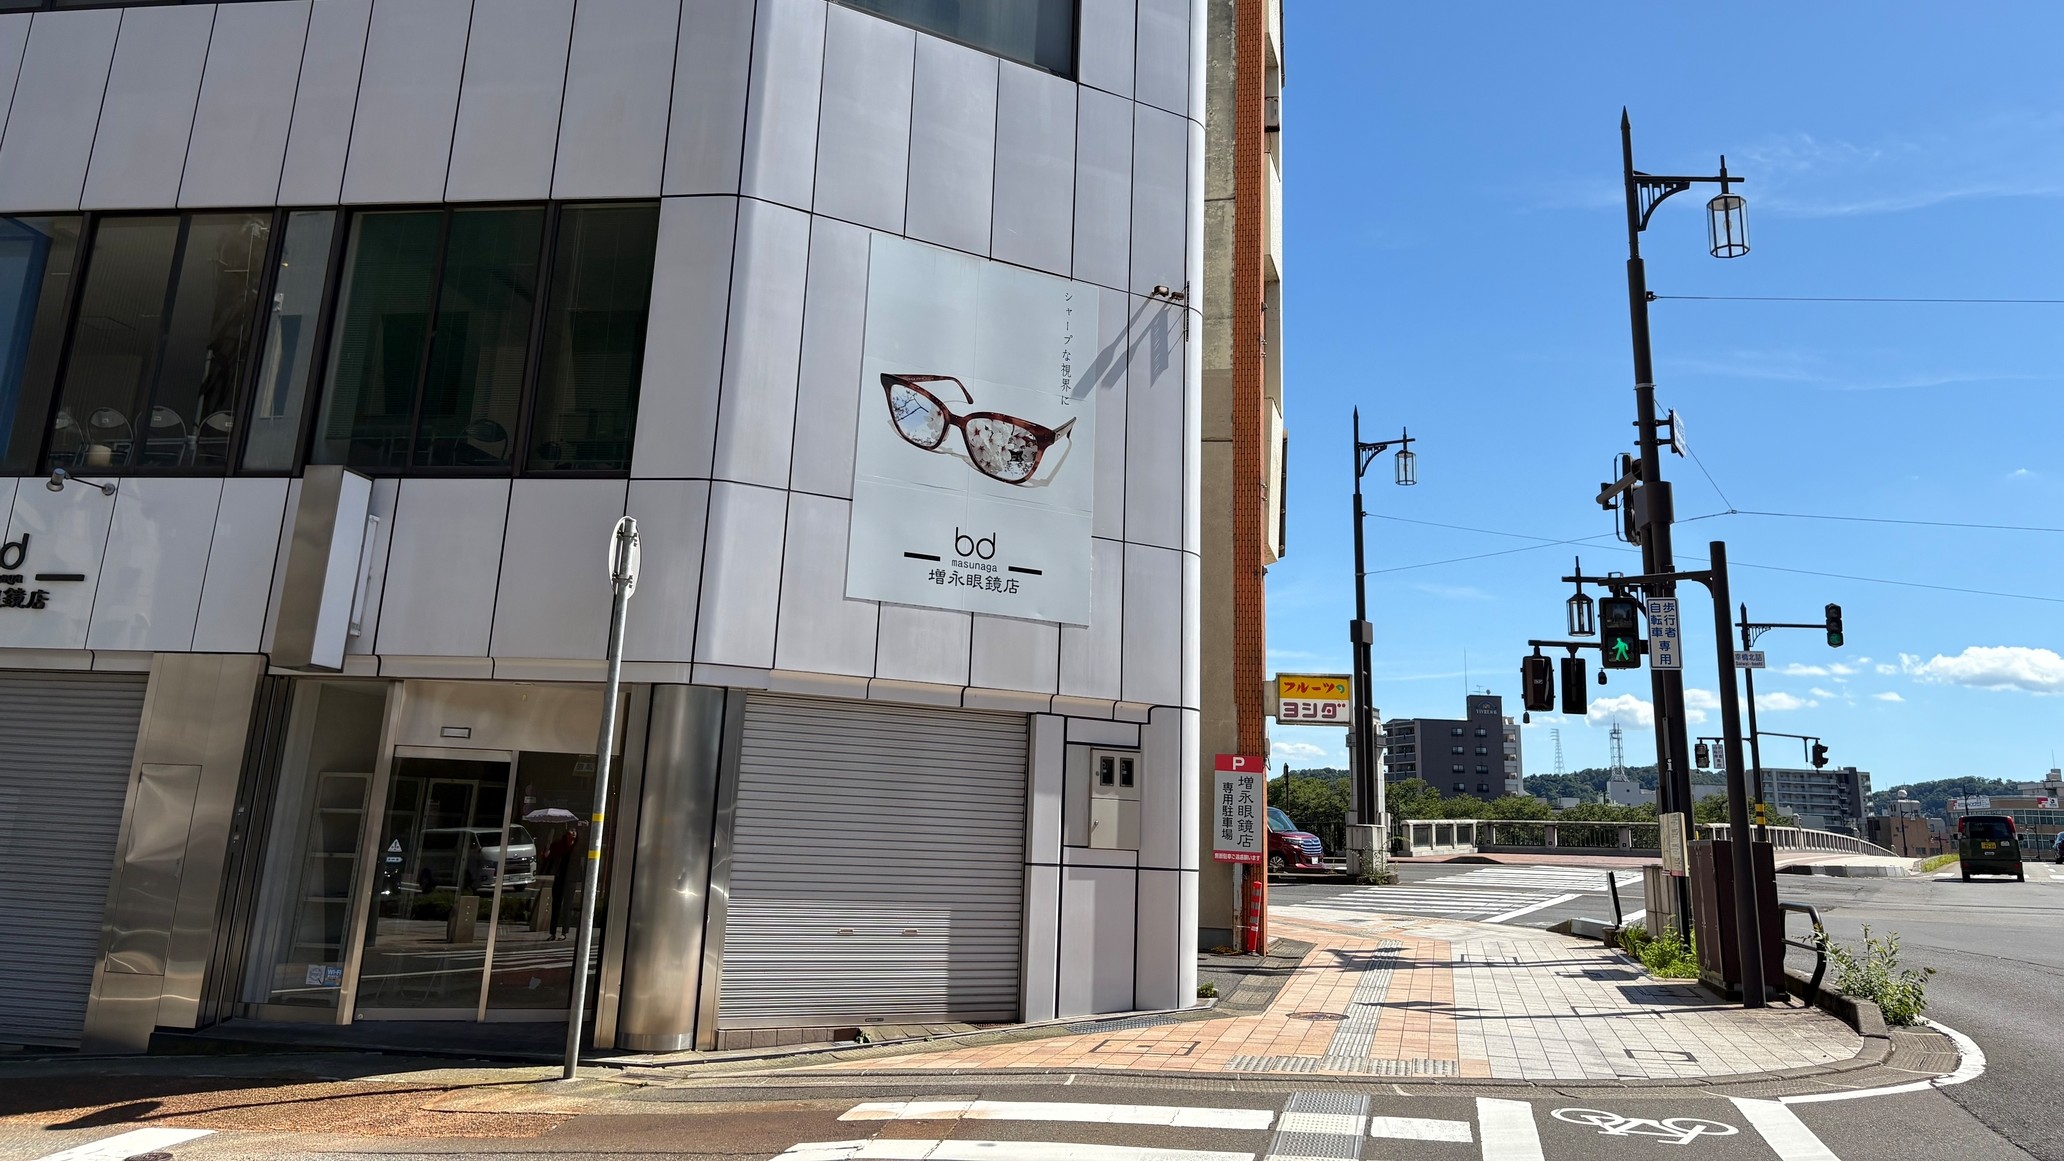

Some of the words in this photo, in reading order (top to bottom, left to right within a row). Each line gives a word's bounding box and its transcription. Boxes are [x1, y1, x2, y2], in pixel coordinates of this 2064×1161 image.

[1060, 292, 1074, 406] シャープな視界に
[955, 526, 996, 560] bd
[951, 559, 998, 573] masunaga
[928, 568, 1020, 594] 増永眼鏡店
[0, 587, 50, 609] 鏡店
[1650, 602, 1663, 638] 自転車
[1662, 602, 1676, 638] 歩行者
[1659, 640, 1672, 665] 専用
[1283, 681, 1345, 694] フルーツの
[1283, 702, 1346, 719] ヨシダ
[1232, 756, 1245, 770] P
[1221, 782, 1234, 841] 専用駐車場
[1237, 775, 1254, 848] 増永眼鏡店
